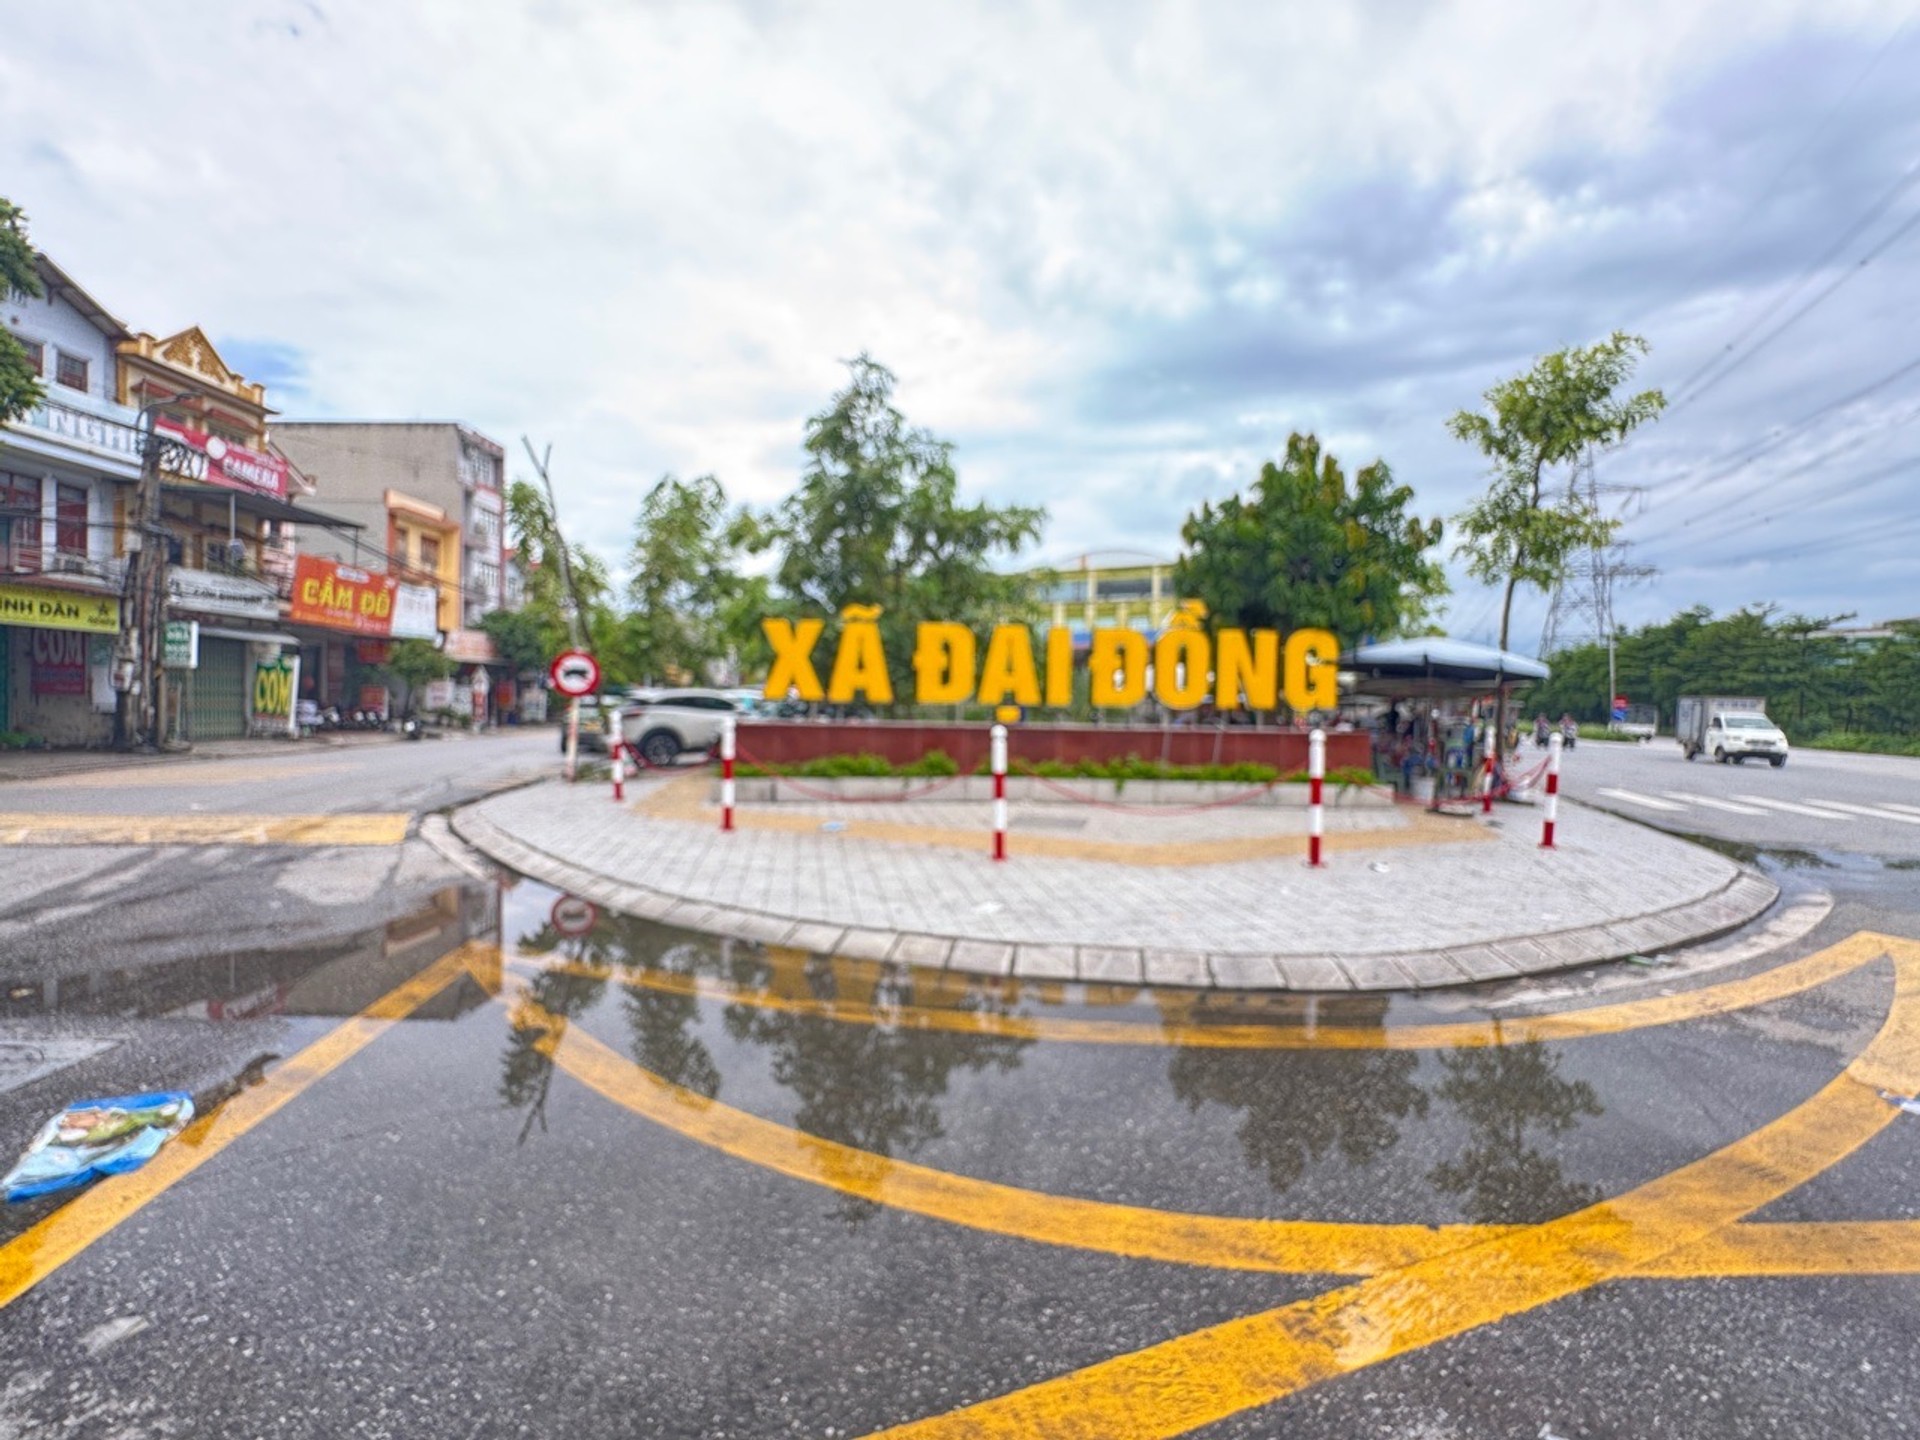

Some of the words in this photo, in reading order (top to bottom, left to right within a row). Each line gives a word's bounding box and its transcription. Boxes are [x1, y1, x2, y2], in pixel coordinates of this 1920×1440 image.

[40, 599, 79, 618] DÂN
[761, 603, 893, 704] XÃ
[912, 620, 1071, 724] ĐẠI
[1088, 597, 1339, 711] ĐỒNG
